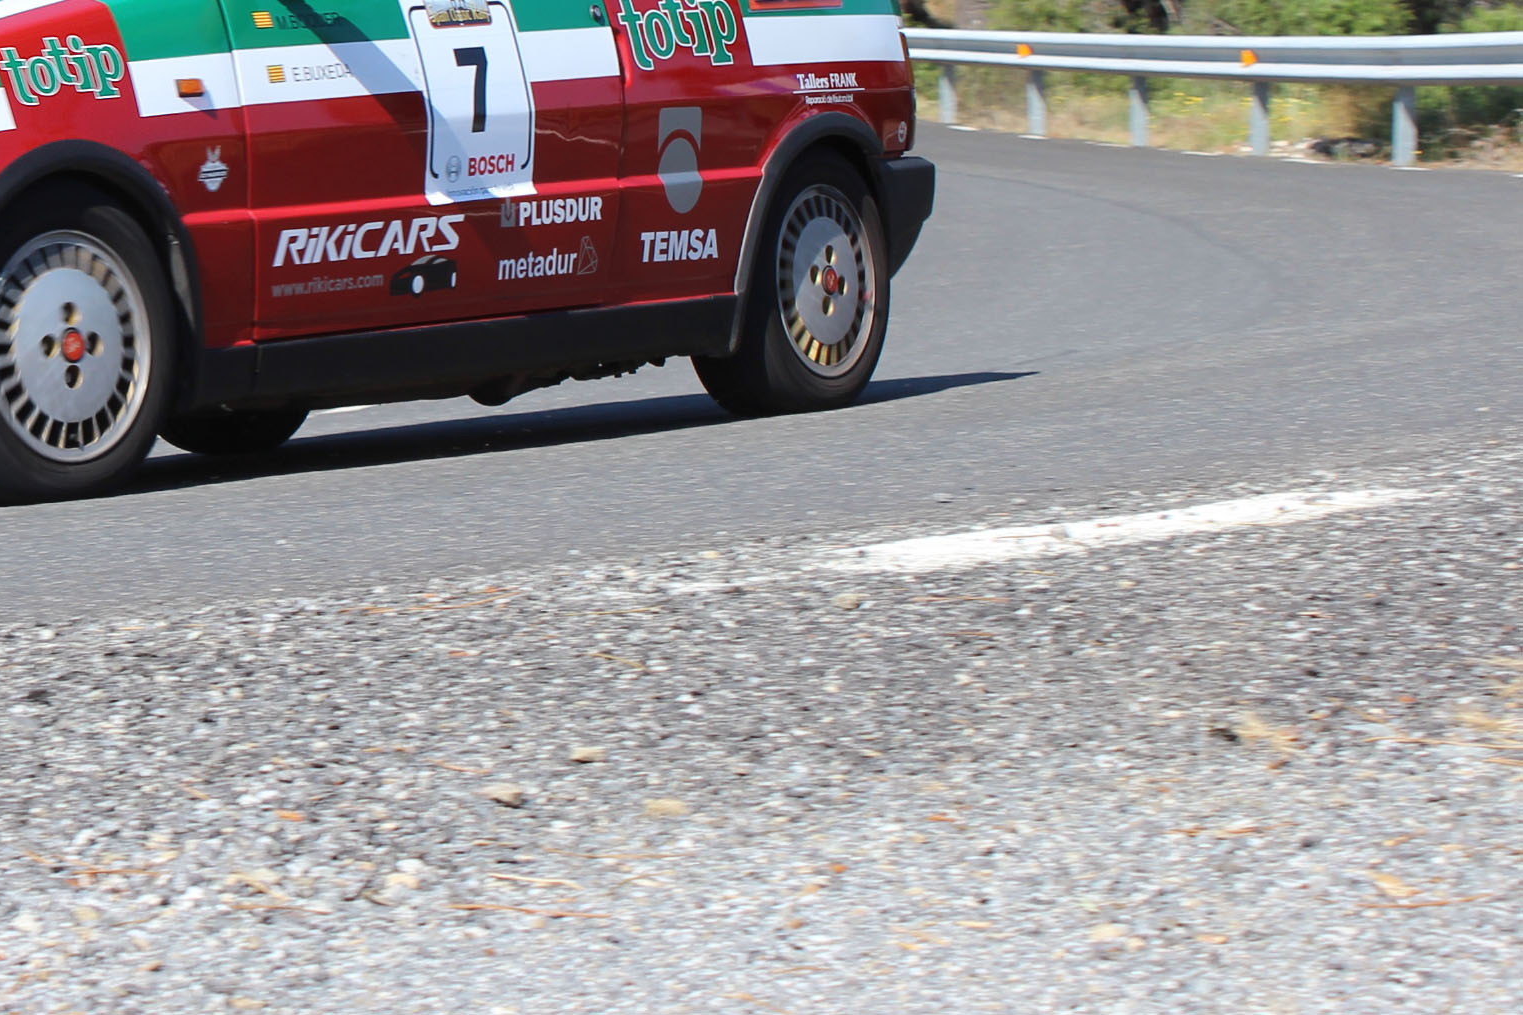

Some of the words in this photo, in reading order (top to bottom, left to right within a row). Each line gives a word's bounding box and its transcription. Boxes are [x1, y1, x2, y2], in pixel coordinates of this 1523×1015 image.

[0, 35, 125, 106] totip
[797, 72, 829, 90] Tallers
[829, 71, 859, 88] FRANK
[453, 46, 488, 133] 7
[468, 153, 516, 177] BOSCH
[518, 196, 603, 227] PLUSDUR
[640, 228, 719, 263] TEMSA
[498, 249, 578, 281] metadur
[271, 273, 384, 298] www.rikicars.com
